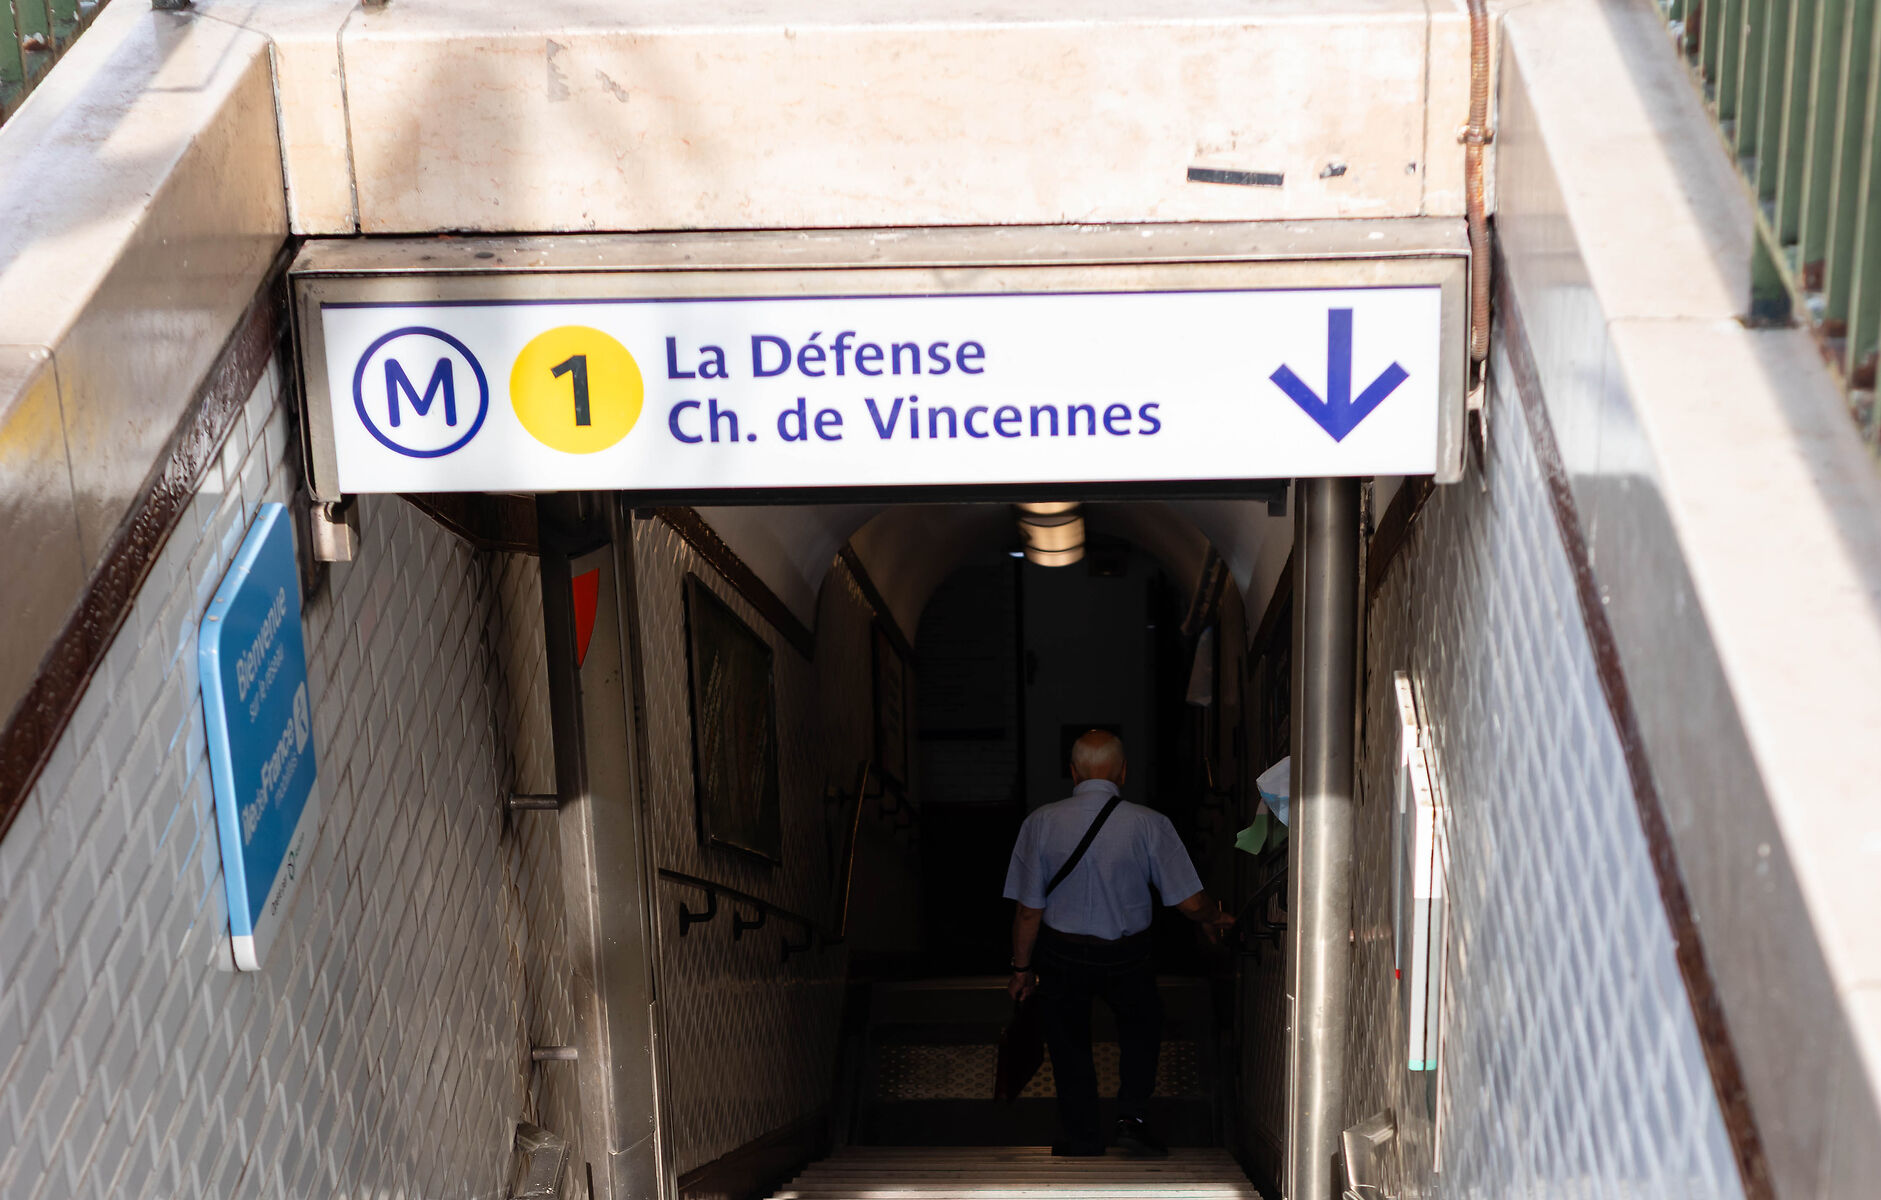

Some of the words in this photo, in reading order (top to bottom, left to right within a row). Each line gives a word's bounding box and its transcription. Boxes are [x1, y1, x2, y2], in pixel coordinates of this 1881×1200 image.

[550, 354, 592, 427] 1
[665, 336, 729, 380] La
[751, 331, 986, 379] Défense
[384, 356, 458, 428] M
[668, 398, 757, 444] Ch.
[777, 397, 844, 442] de
[864, 395, 1161, 441] Vincennes
[236, 586, 286, 702] Bienvenue
